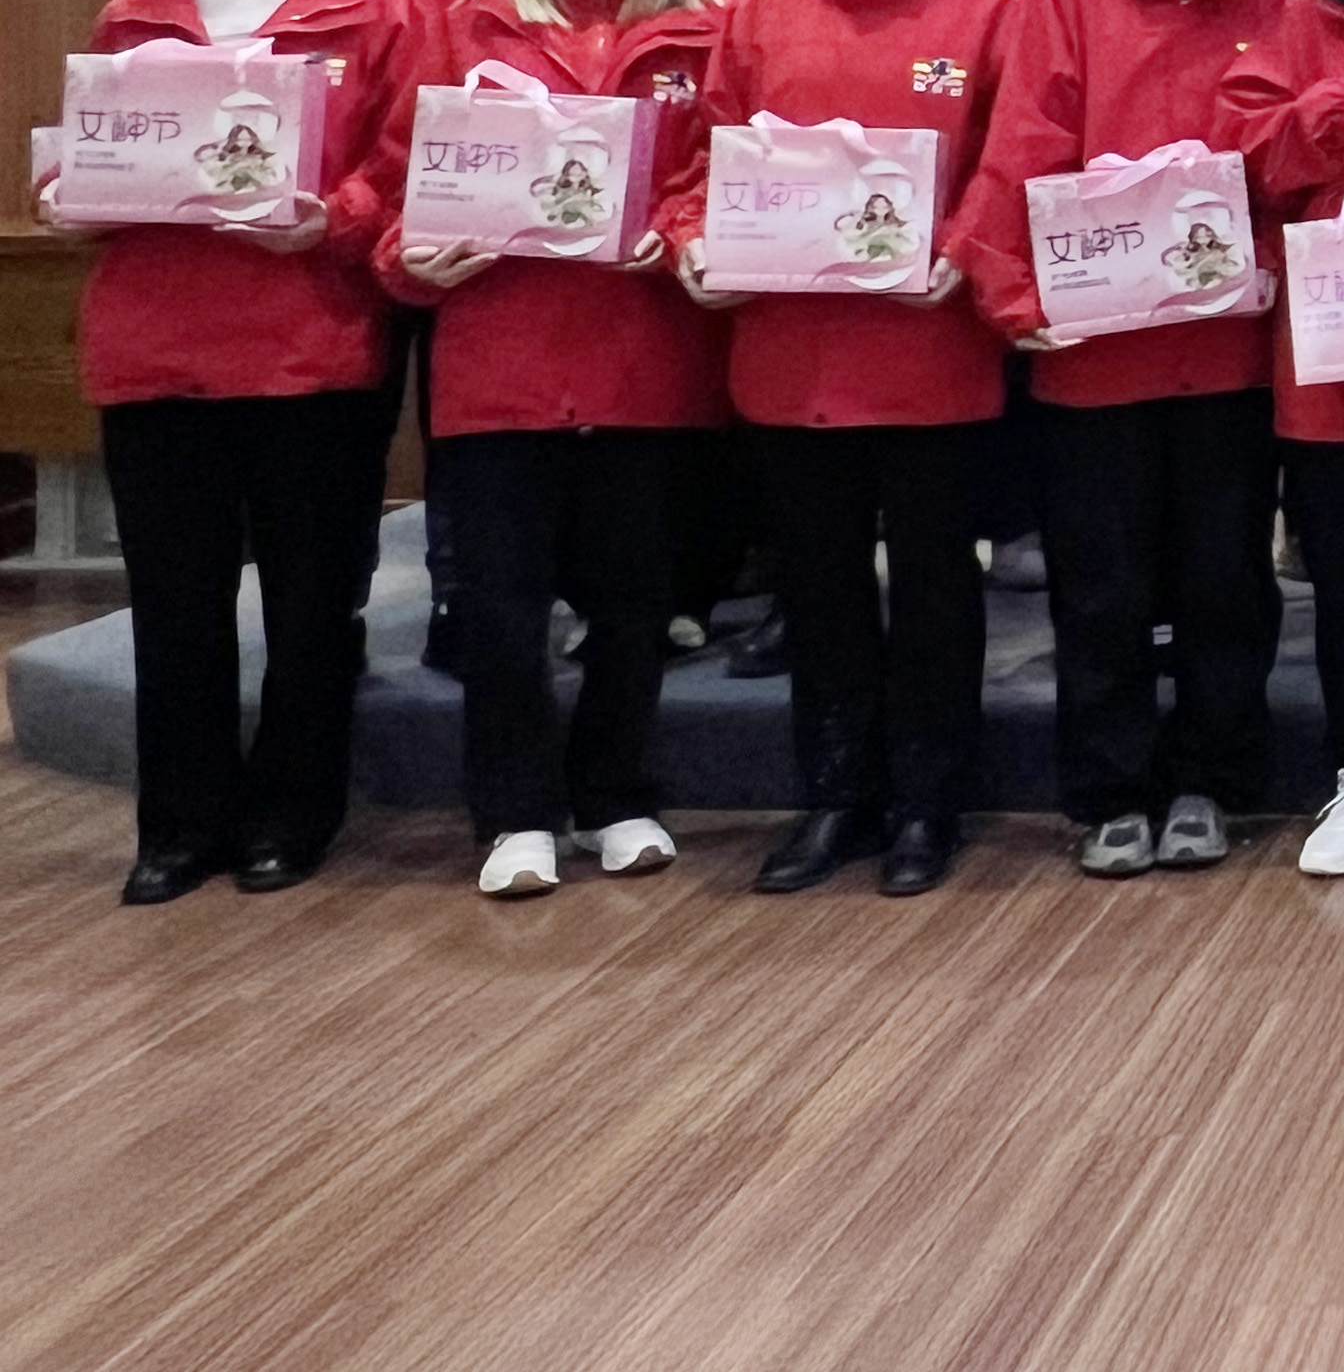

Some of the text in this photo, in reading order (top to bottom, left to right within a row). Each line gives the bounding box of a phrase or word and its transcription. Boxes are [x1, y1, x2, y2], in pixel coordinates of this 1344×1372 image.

[76, 110, 182, 144] 女神节
[421, 140, 520, 175] 女神节
[719, 179, 822, 213] 女神节
[1045, 222, 1145, 266] 女神节
